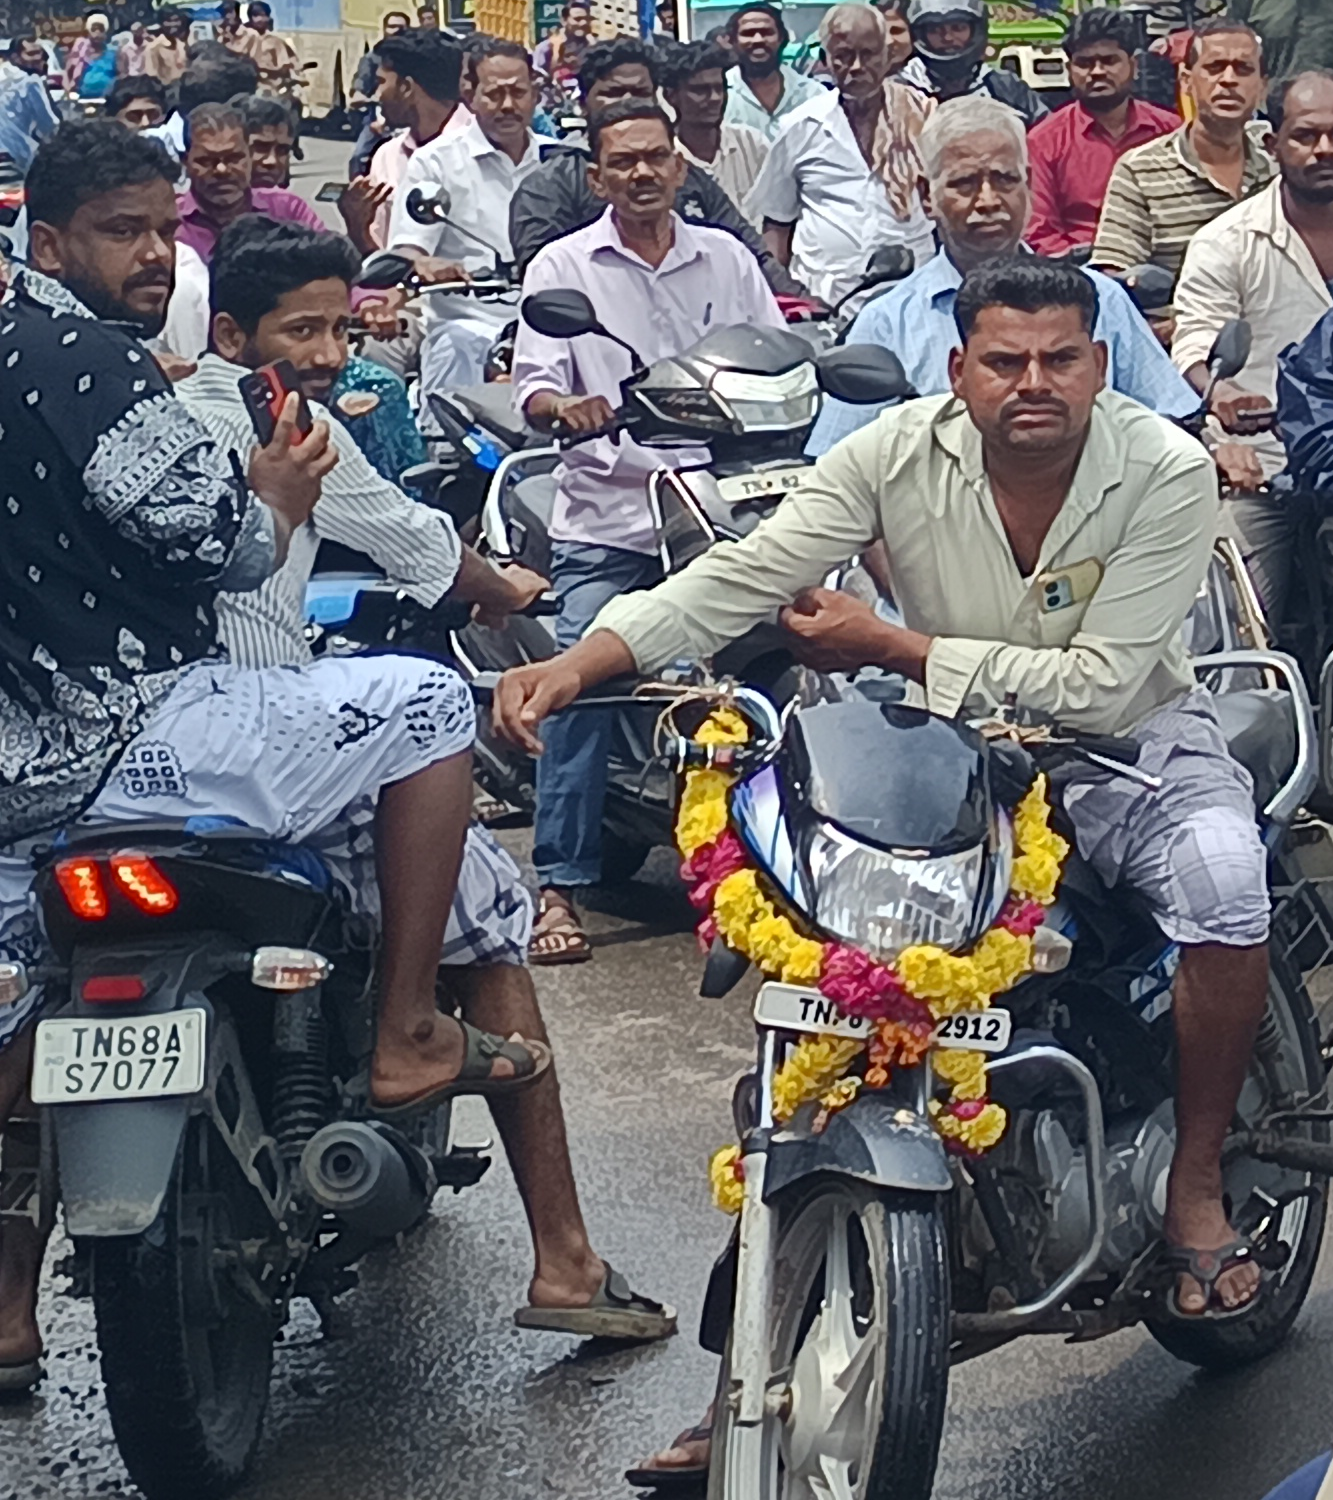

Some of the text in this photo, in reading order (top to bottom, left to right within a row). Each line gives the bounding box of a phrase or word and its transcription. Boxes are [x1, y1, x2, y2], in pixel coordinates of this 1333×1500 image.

[73, 1023, 182, 1059] TN68A
[937, 1015, 1001, 1042] 2912
[65, 1056, 180, 1094] S7077
